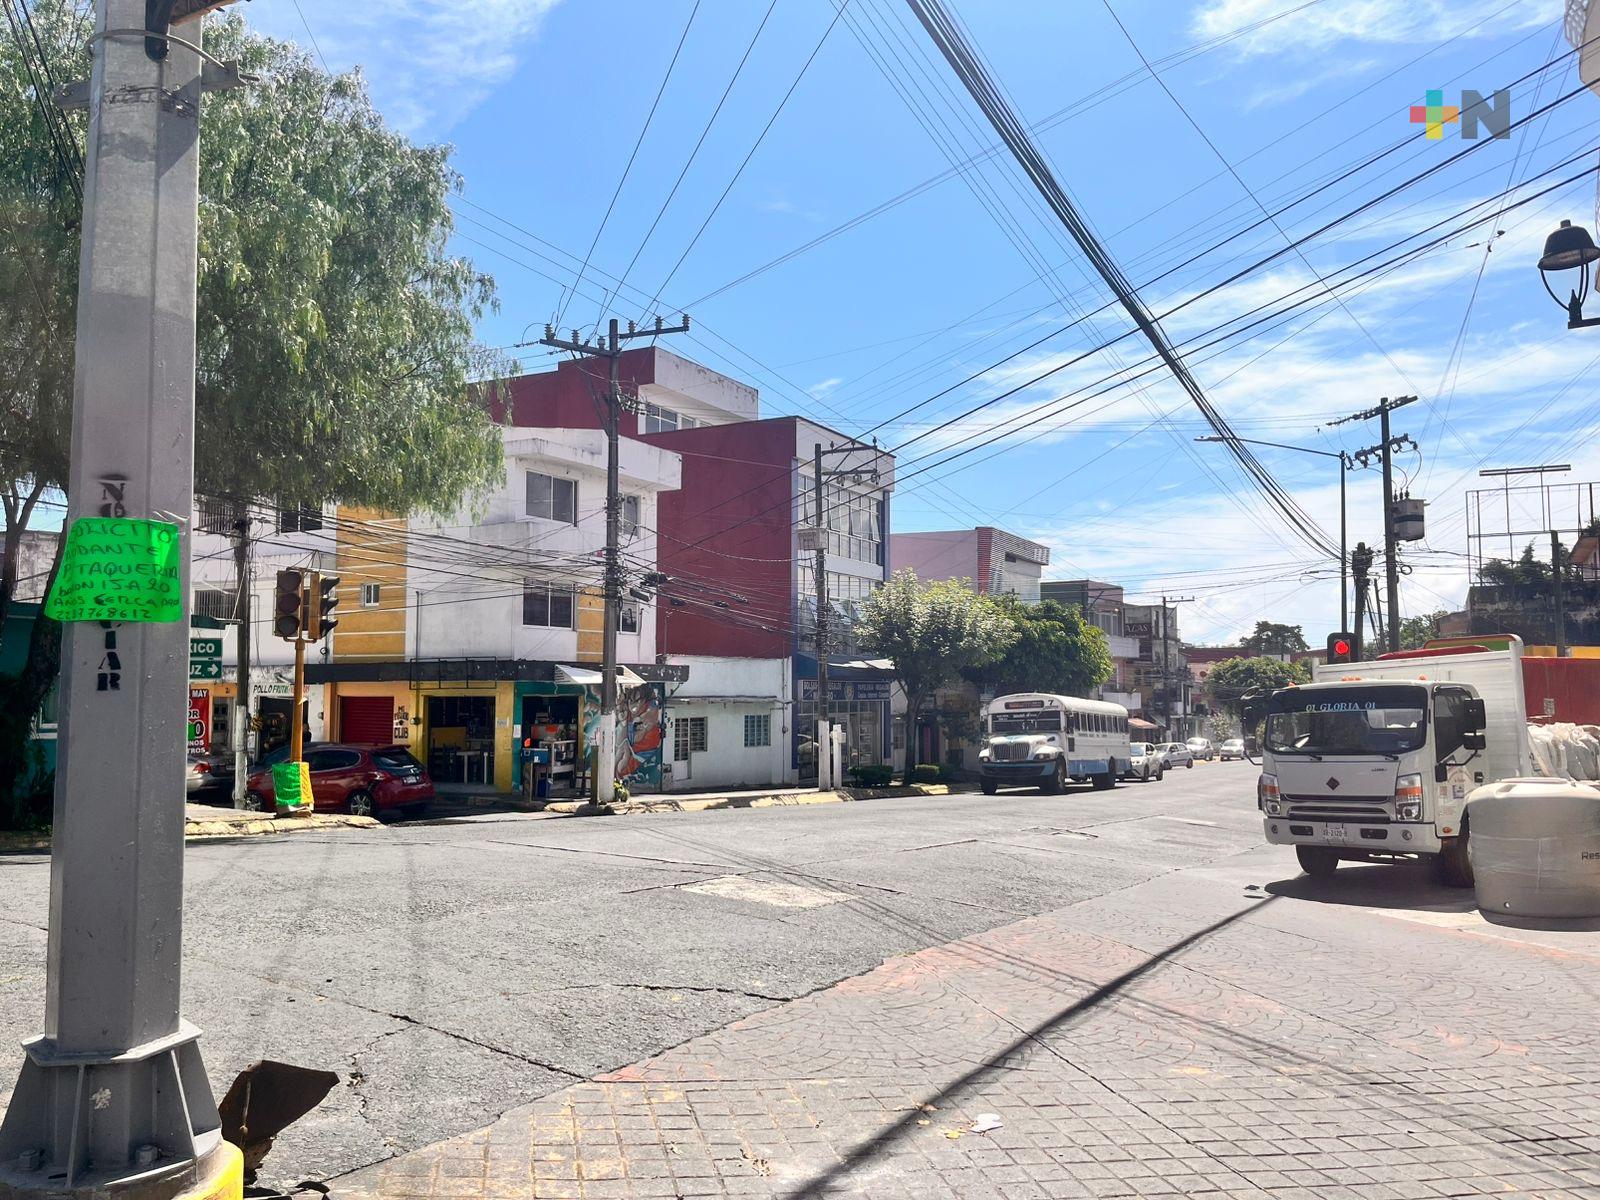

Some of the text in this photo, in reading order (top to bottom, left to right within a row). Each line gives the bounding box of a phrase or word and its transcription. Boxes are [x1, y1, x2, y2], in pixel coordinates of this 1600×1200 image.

[191, 689, 208, 698] MAY
[253, 684, 272, 694] POLLO
[1047, 699, 1055, 707] 7
[1320, 702, 1360, 713] GLORIA
